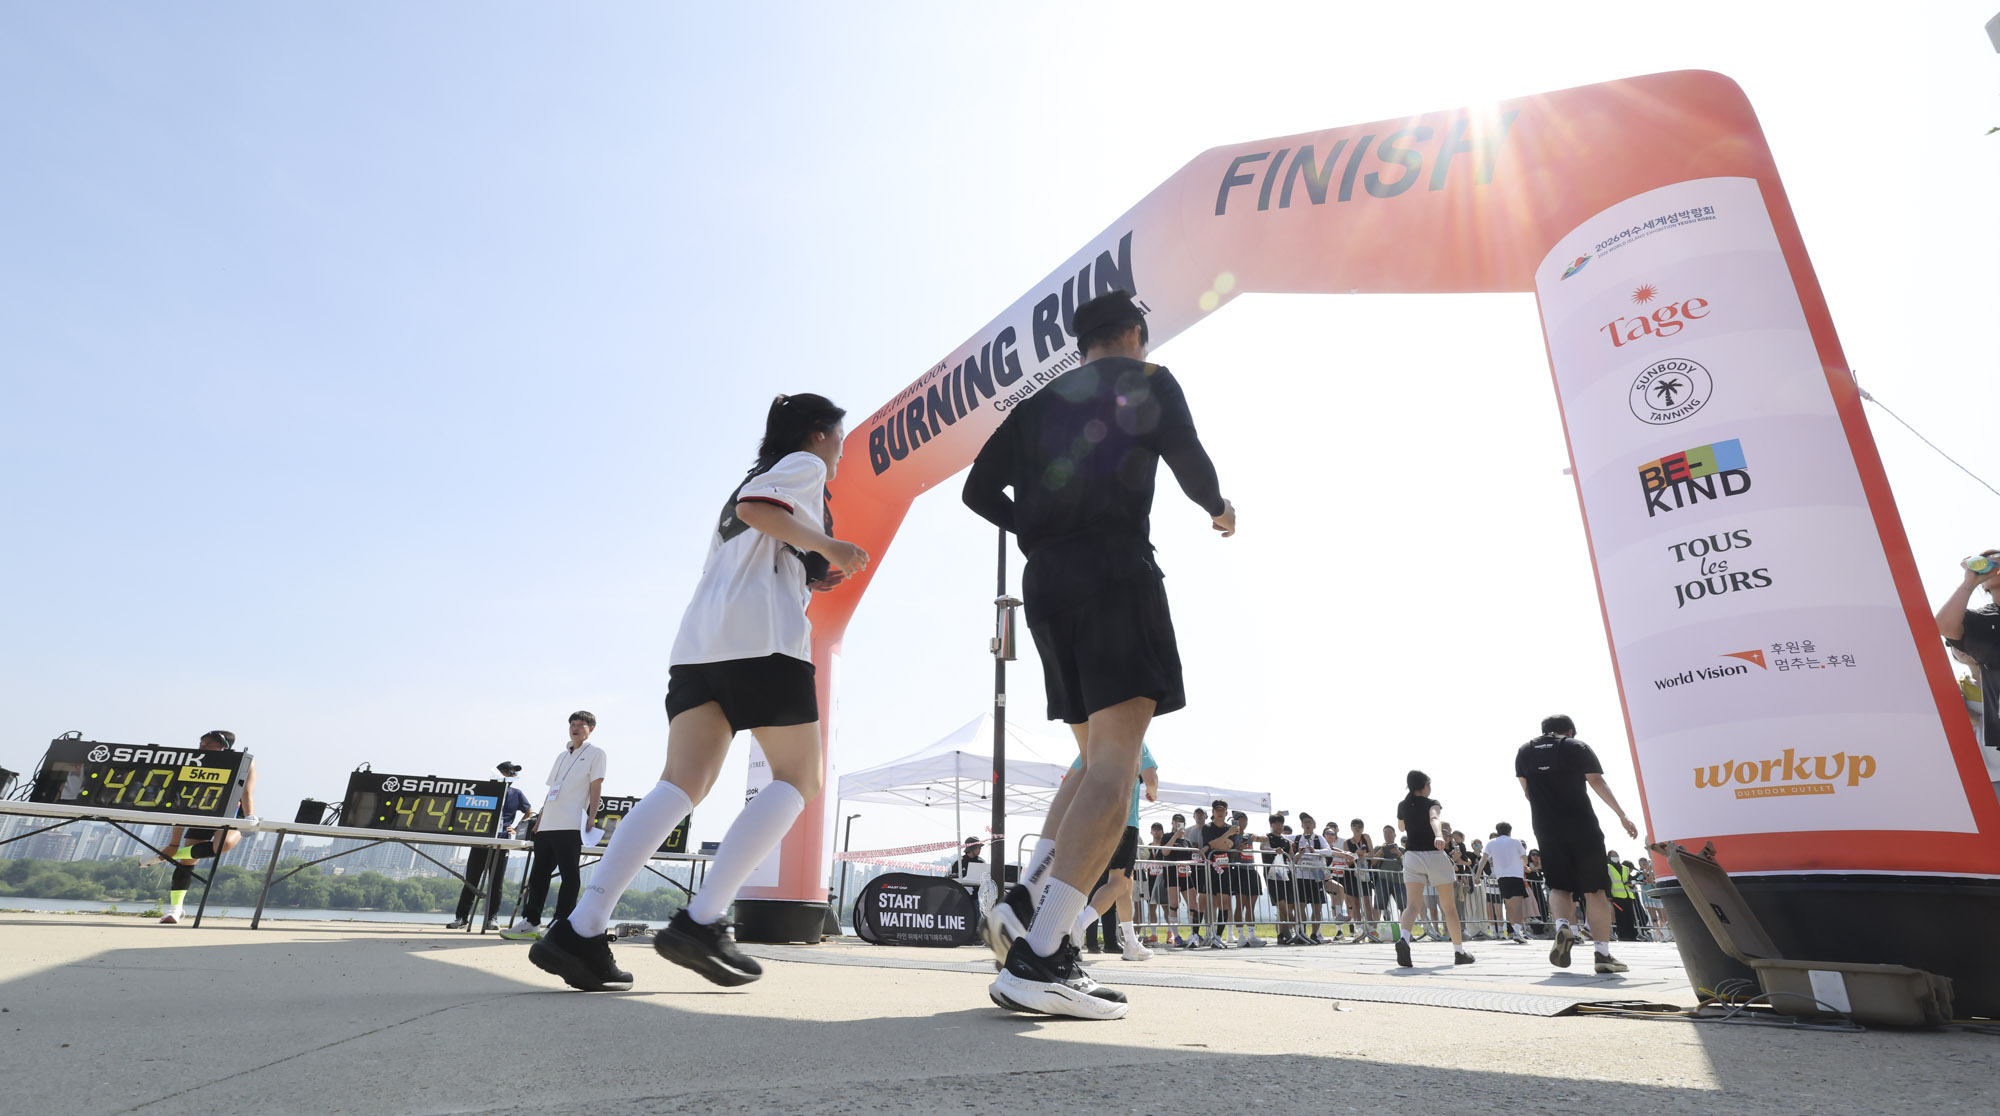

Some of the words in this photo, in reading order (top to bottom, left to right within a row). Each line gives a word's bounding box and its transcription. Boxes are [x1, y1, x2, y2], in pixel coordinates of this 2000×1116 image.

[1214, 109, 1521, 216] FINISH
[1594, 205, 1715, 253] 2026여수세계섬박람회
[1677, 218, 1697, 227] YEOSU
[868, 325, 1024, 477] BURNING
[1032, 229, 1137, 364] RUN
[993, 379, 1037, 412] Casual
[1033, 350, 1082, 386] Runnin
[1636, 361, 1697, 391] SUNBODY
[1649, 398, 1701, 422] TANNING
[1645, 468, 1752, 518] KIND
[1668, 529, 1752, 562] TOUS
[1701, 557, 1728, 576] les
[1674, 568, 1772, 609] JOURS
[1770, 639, 1816, 655] 후원을
[1654, 670, 1694, 691] World
[1696, 663, 1748, 681] Vision
[112, 748, 206, 767] SAMIK
[188, 769, 220, 781] 5km
[402, 779, 477, 795] SAMIK
[1737, 788, 1786, 797] OUTDOOR
[1791, 785, 1831, 793] OUTLET
[465, 796, 489, 807] 7km
[879, 892, 921, 910] START
[880, 911, 934, 929] WAITING
[937, 914, 966, 930] LINE
